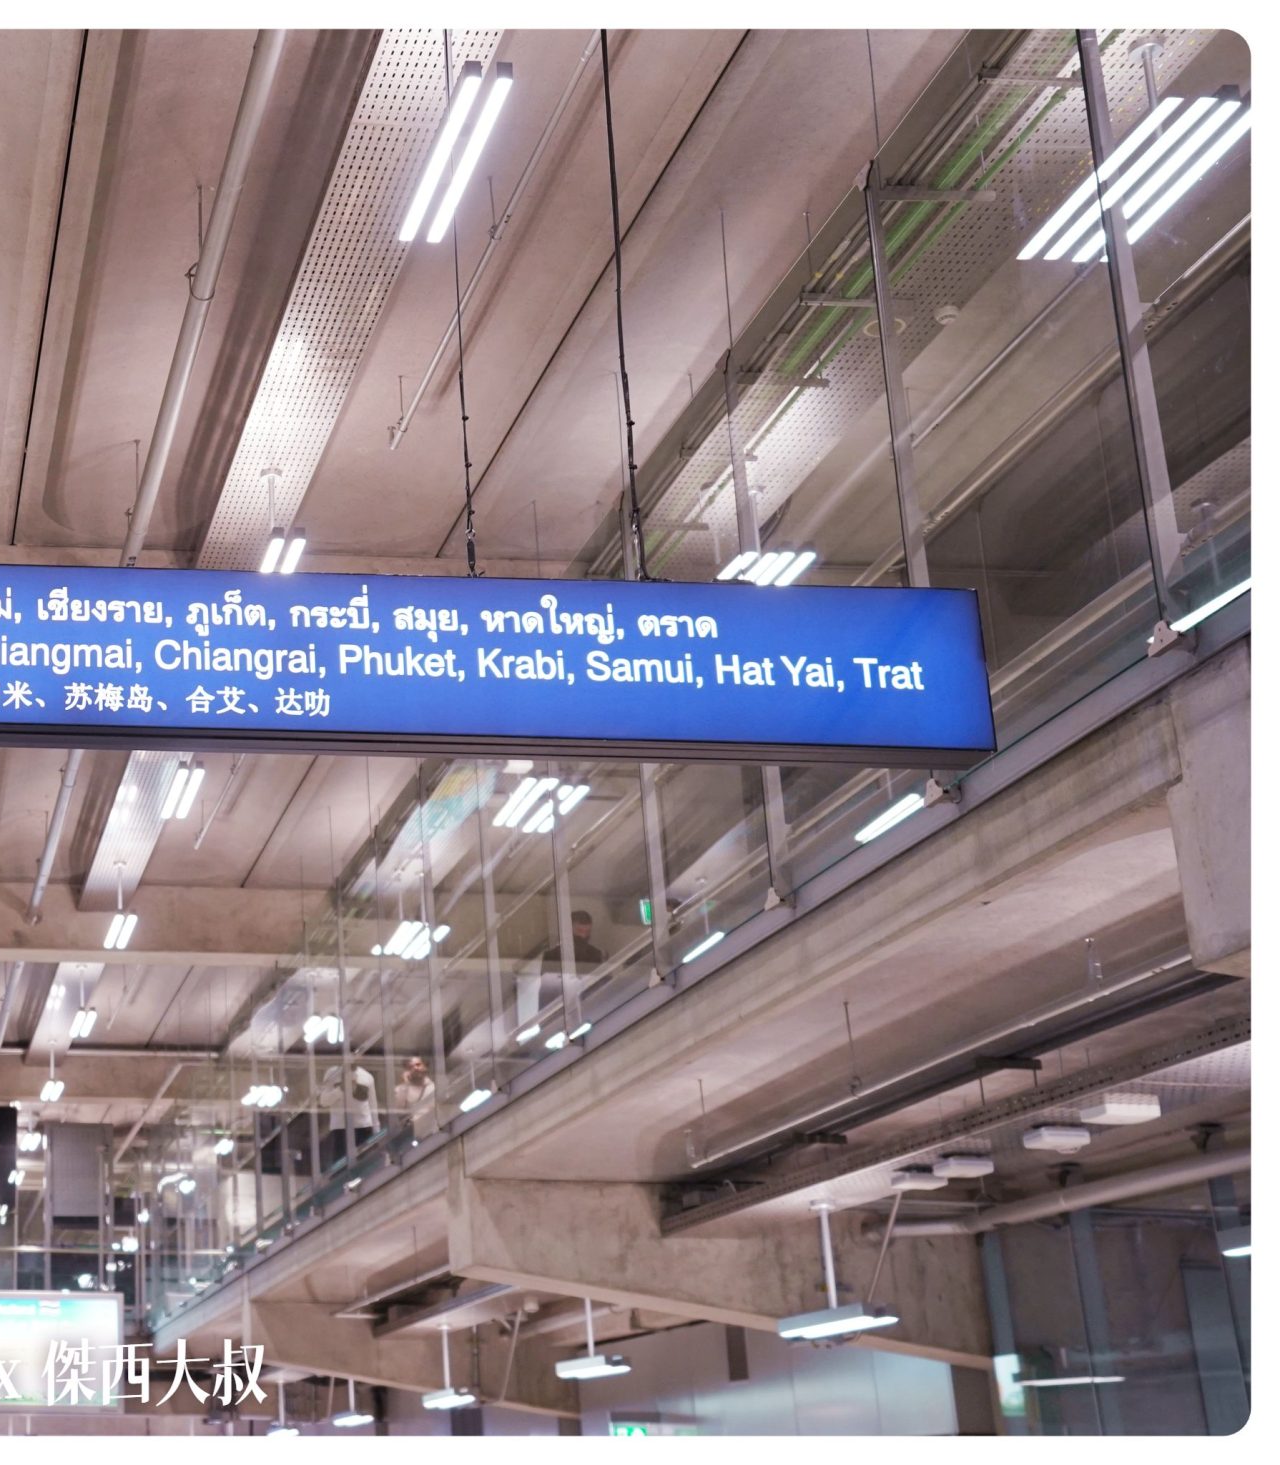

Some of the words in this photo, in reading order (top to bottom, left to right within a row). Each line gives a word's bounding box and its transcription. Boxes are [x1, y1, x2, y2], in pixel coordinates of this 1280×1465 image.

[38, 587, 173, 628] เชียงราย,
[186, 589, 276, 637] ภูเก็ต,
[290, 585, 380, 634] กระบี่,
[393, 606, 469, 644] สมุย,
[480, 593, 625, 645] หาดใหญ่,
[638, 614, 718, 639] ตราด
[155, 639, 327, 680] Chiangrai,
[339, 644, 466, 683] Phuket,
[478, 648, 575, 685] Krabi,
[587, 651, 704, 688] Samui,
[715, 654, 775, 686] Hat
[780, 656, 845, 692] Yai,
[853, 658, 925, 690] Trat
